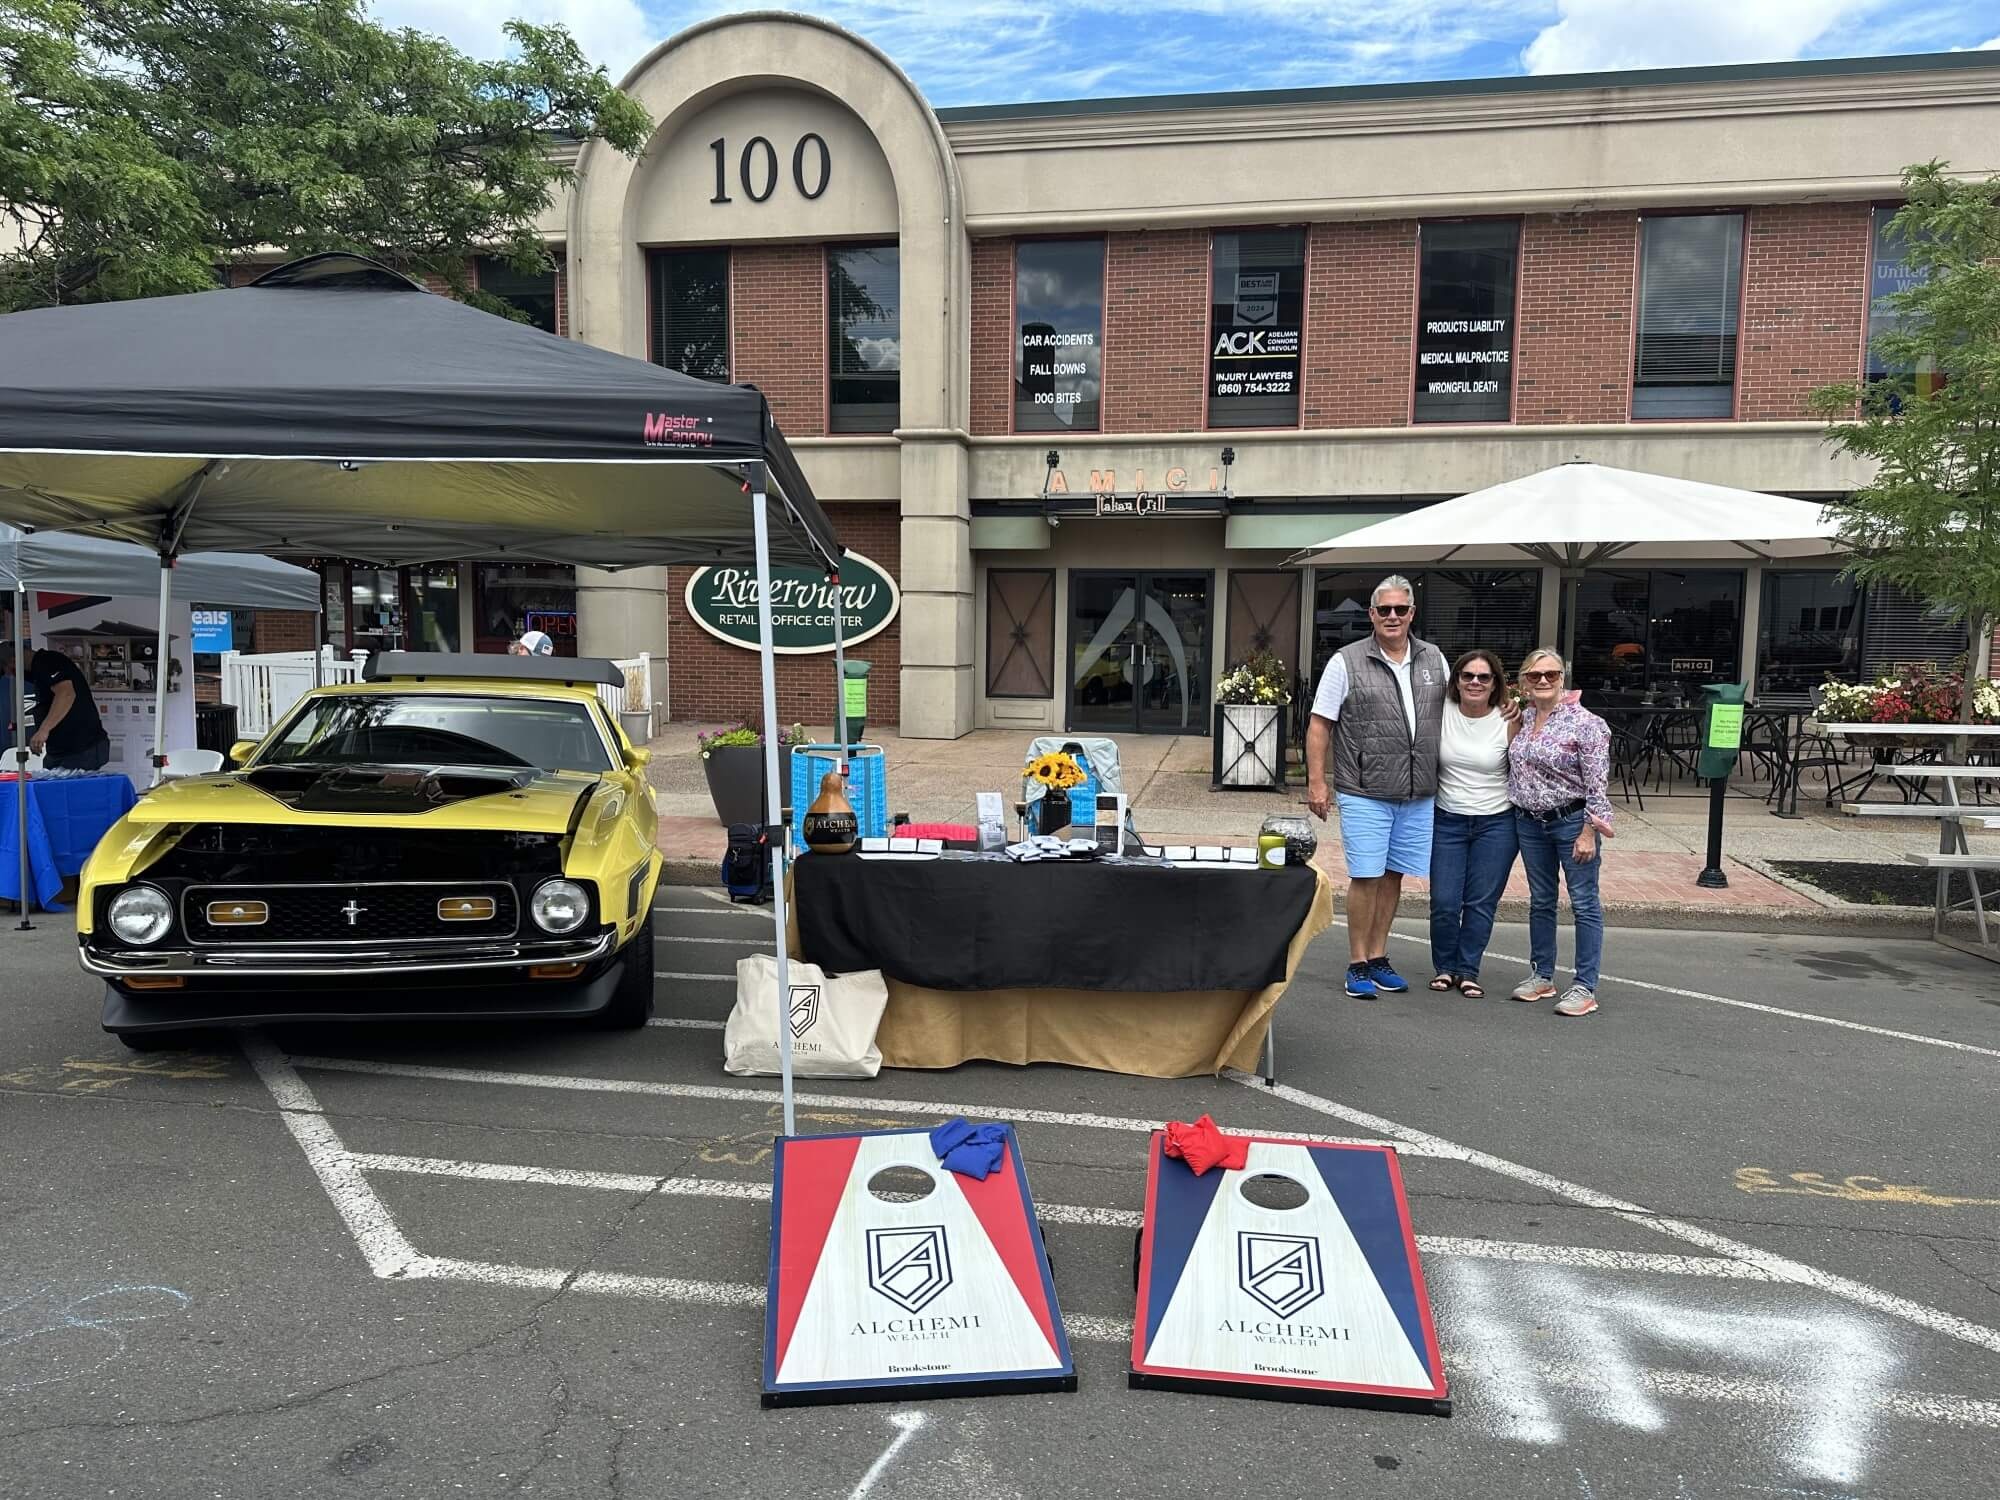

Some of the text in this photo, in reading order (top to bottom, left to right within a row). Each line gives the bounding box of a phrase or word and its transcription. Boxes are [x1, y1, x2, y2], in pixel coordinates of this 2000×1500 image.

[710, 132, 831, 203] 100
[1426, 319, 1505, 334] PRODUCTS LIABILITY
[1023, 333, 1094, 347] CAR ACCIDENTS
[1213, 330, 1267, 355] ACK
[1420, 350, 1509, 365] MEDICAL MALPRACTICE
[1030, 362, 1086, 376] FALL DOWNS
[1215, 371, 1294, 382] INJURY LAWYERS
[1217, 382, 1291, 396] (860) 754-3222
[1428, 380, 1498, 394] WRONGFUL DEATH
[1034, 392, 1082, 404] DOG BITES
[644, 413, 700, 441] Master
[1050, 466, 1219, 493] AMICI
[1095, 492, 1167, 516] Italian Grill
[191, 611, 228, 625] eals
[719, 614, 758, 625] RETAIL
[771, 615, 812, 626] OFFICE
[772, 1041, 822, 1052] AHEMI
[851, 1315, 982, 1336] ALCHEMI
[1218, 1319, 1352, 1341] ALCHEMI
[887, 1331, 950, 1342] WEALTH
[1254, 1335, 1318, 1347] WEALTH
[888, 1363, 952, 1373] Brookstone
[1254, 1363, 1319, 1376] Brookstone
